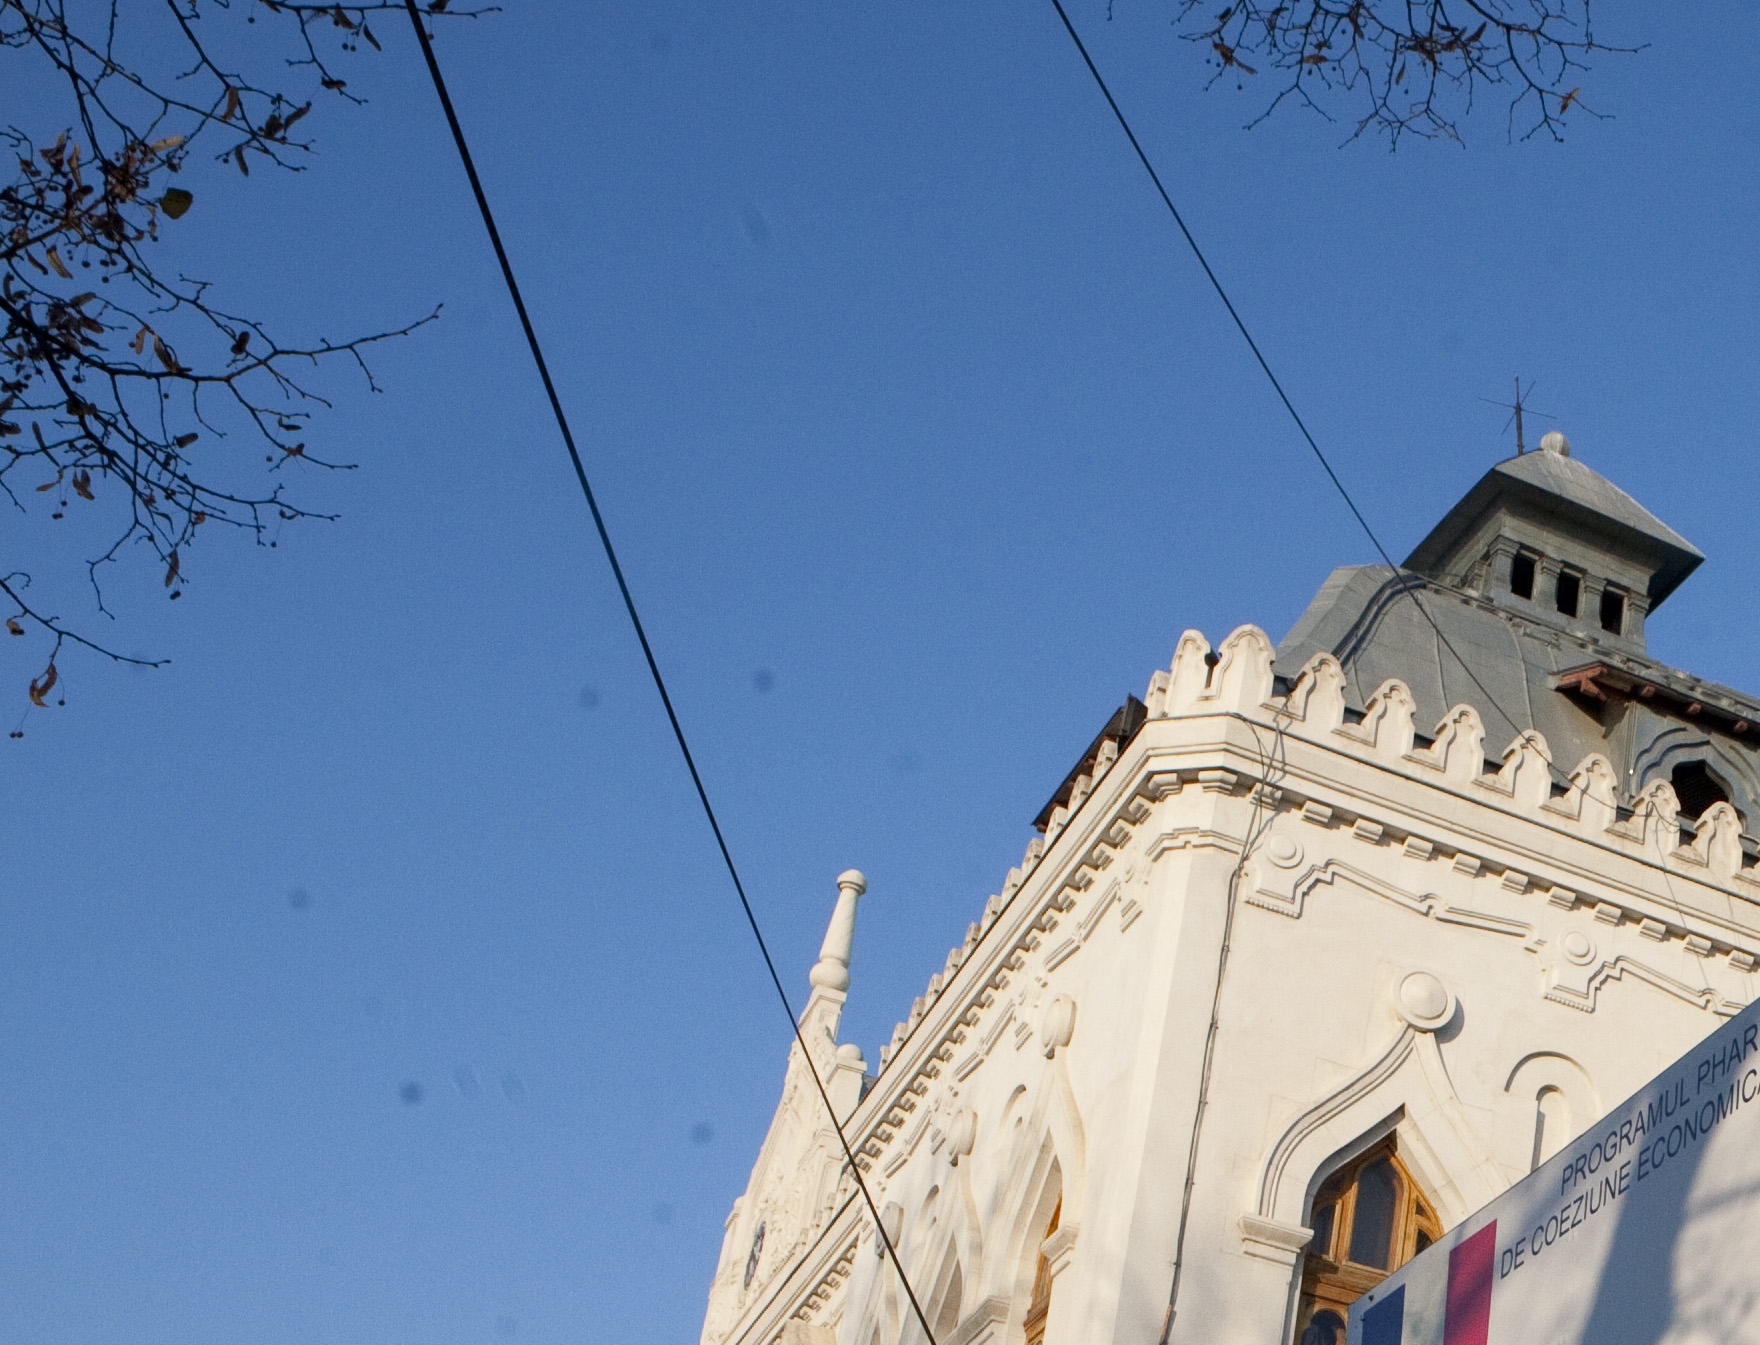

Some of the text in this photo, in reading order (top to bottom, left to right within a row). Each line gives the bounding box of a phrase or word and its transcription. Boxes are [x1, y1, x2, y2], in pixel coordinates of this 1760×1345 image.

[1560, 1077, 1691, 1197] PROGRAMUL
[1500, 1235, 1527, 1280] DE
[1530, 1159, 1632, 1257] COEZIUNE
